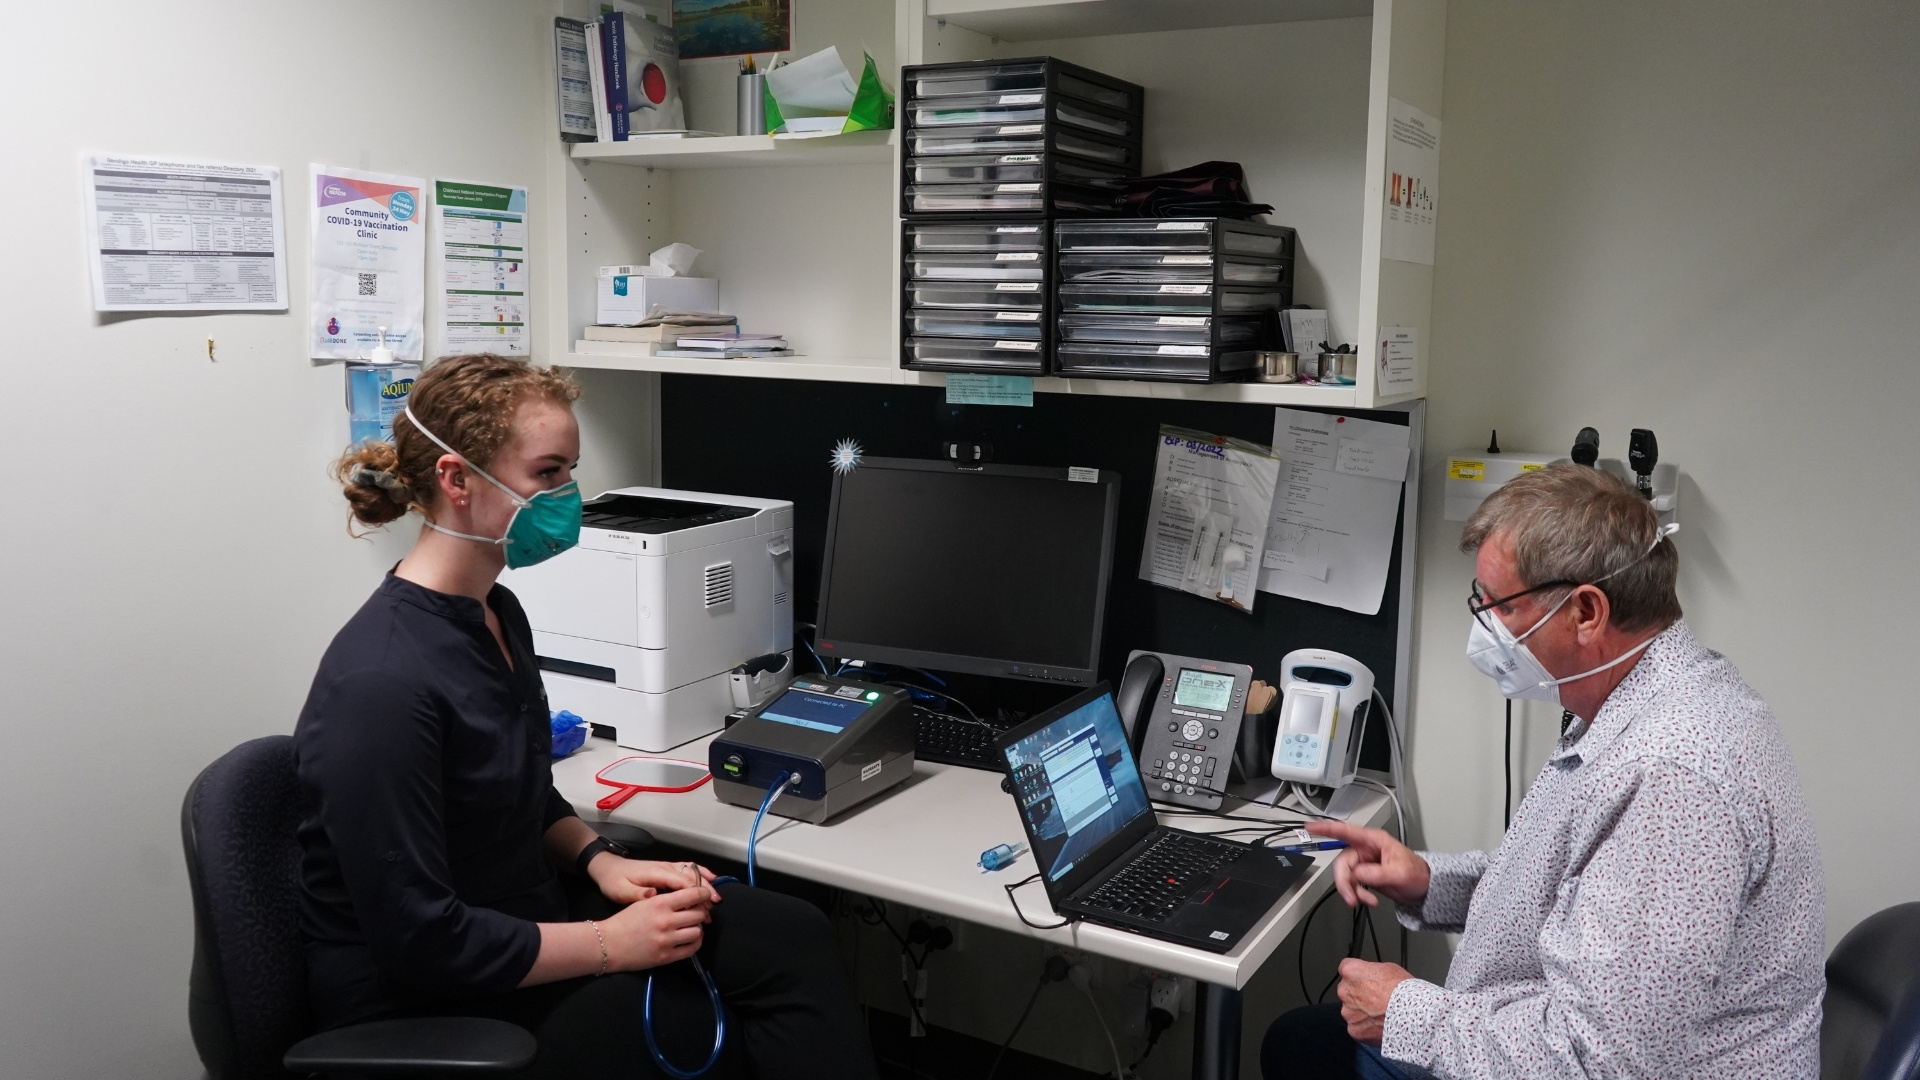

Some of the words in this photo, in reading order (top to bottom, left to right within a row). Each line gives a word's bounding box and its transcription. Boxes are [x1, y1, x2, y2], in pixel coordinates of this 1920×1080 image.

[223, 165, 245, 173] Directory
[397, 195, 410, 203] from
[392, 200, 413, 211] Monday
[344, 207, 389, 221] Community
[399, 207, 411, 216] May
[326, 215, 363, 228] COVID-19
[363, 220, 408, 232] Vaccination
[356, 229, 378, 239] Clinic
[1163, 435, 1184, 447] EXP:
[1185, 439, 1226, 458] 03/2022
[803, 696, 832, 706] Connected
